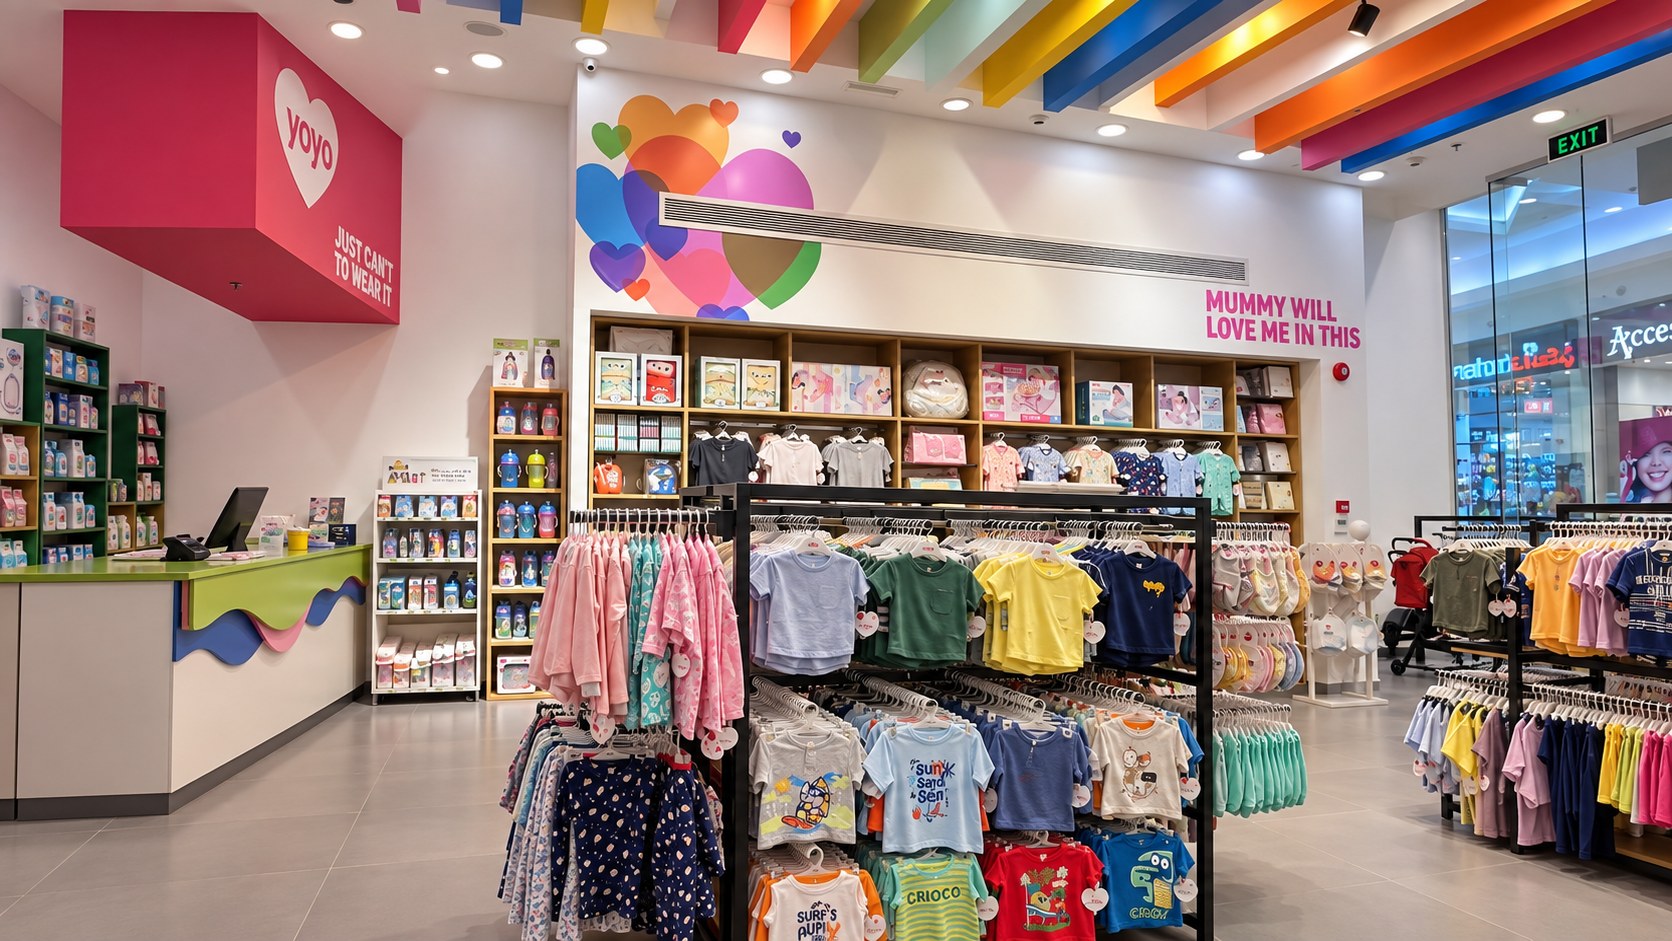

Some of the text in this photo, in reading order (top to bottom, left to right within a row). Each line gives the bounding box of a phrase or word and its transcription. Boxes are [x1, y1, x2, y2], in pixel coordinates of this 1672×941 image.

[287, 107, 333, 171] yoyo
[1558, 126, 1598, 154] EXIT
[335, 225, 394, 283] JUST CAN'T
[334, 250, 392, 307] TO WEAR IT
[1206, 289, 1337, 322] MUMMY WILL
[1206, 316, 1361, 349] LOVE ME IN THIS
[1606, 323, 1672, 360] Acce
[907, 886, 961, 905] CRIOCO
